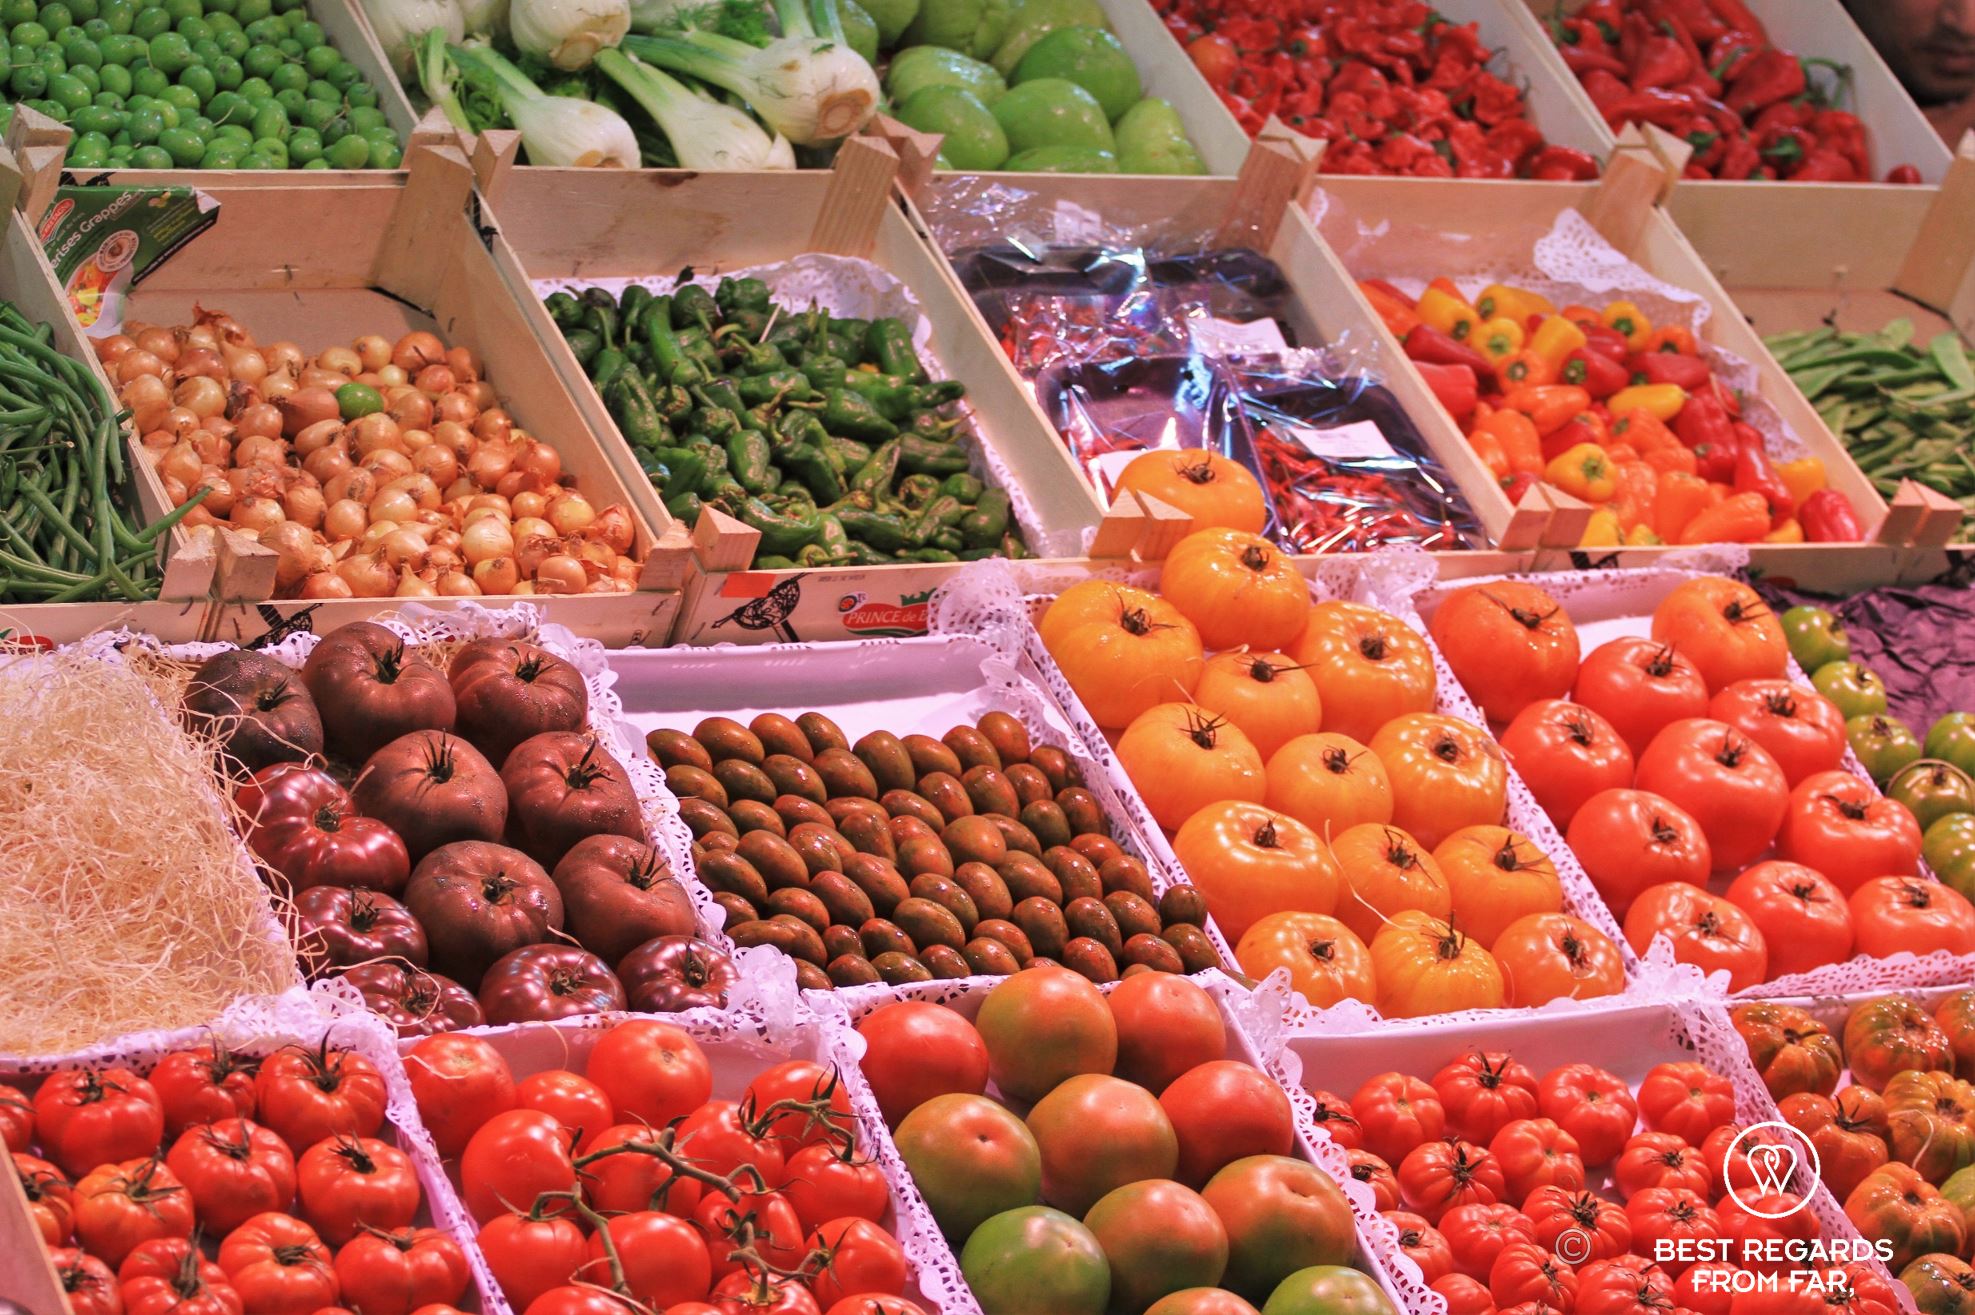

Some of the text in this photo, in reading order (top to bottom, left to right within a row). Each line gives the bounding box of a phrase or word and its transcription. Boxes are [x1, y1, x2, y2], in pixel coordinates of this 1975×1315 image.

[50, 231, 82, 269] erises
[80, 191, 132, 233] Grappes
[846, 609, 902, 624] PRINCE
[902, 610, 916, 623] de
